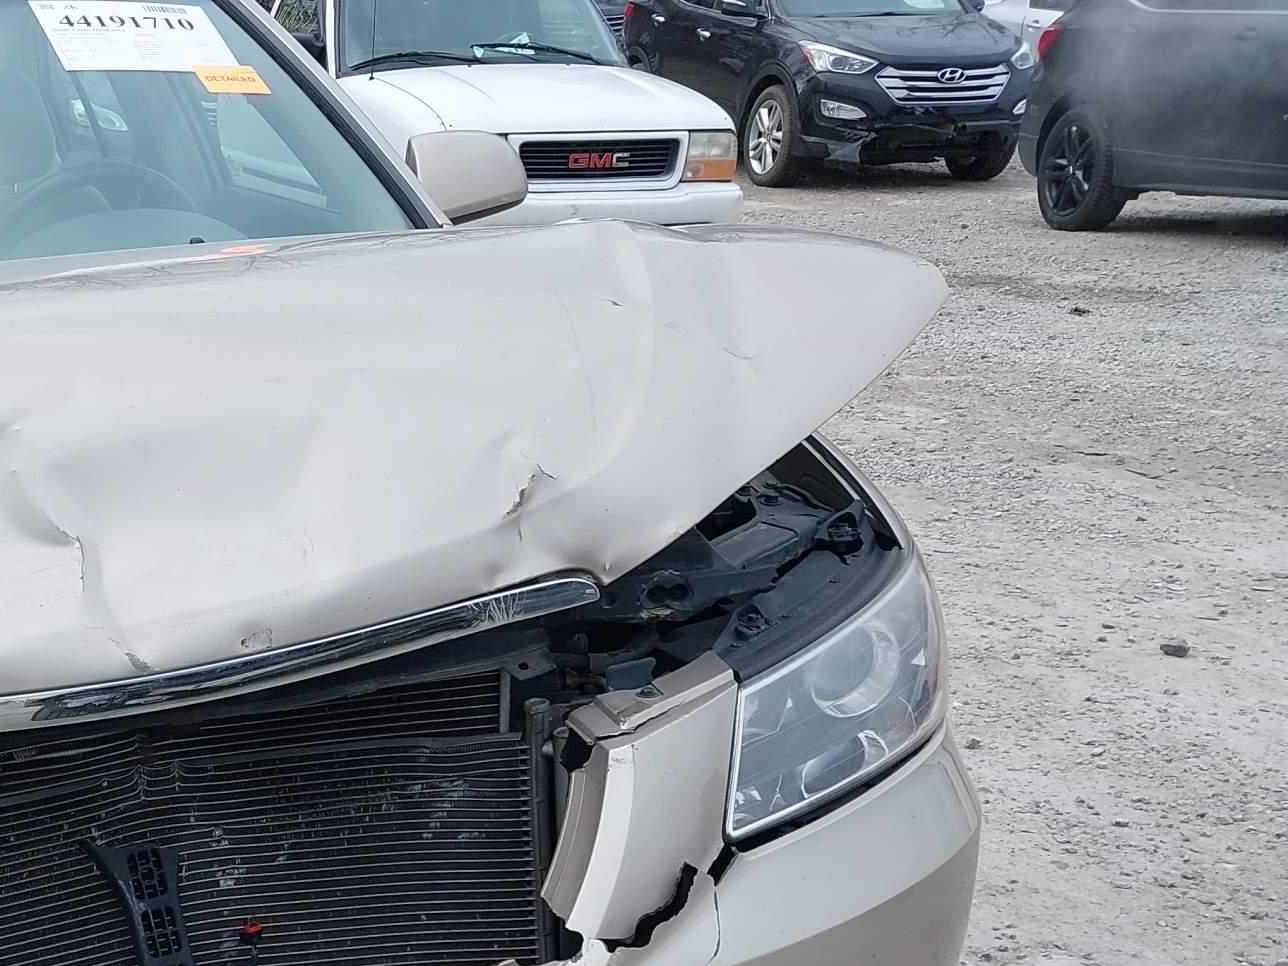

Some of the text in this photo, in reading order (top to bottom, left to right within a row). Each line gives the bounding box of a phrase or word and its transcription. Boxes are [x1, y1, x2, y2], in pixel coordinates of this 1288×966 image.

[59, 14, 194, 31] 44191710
[205, 74, 256, 83] DETAILED
[568, 152, 631, 169] GMC
